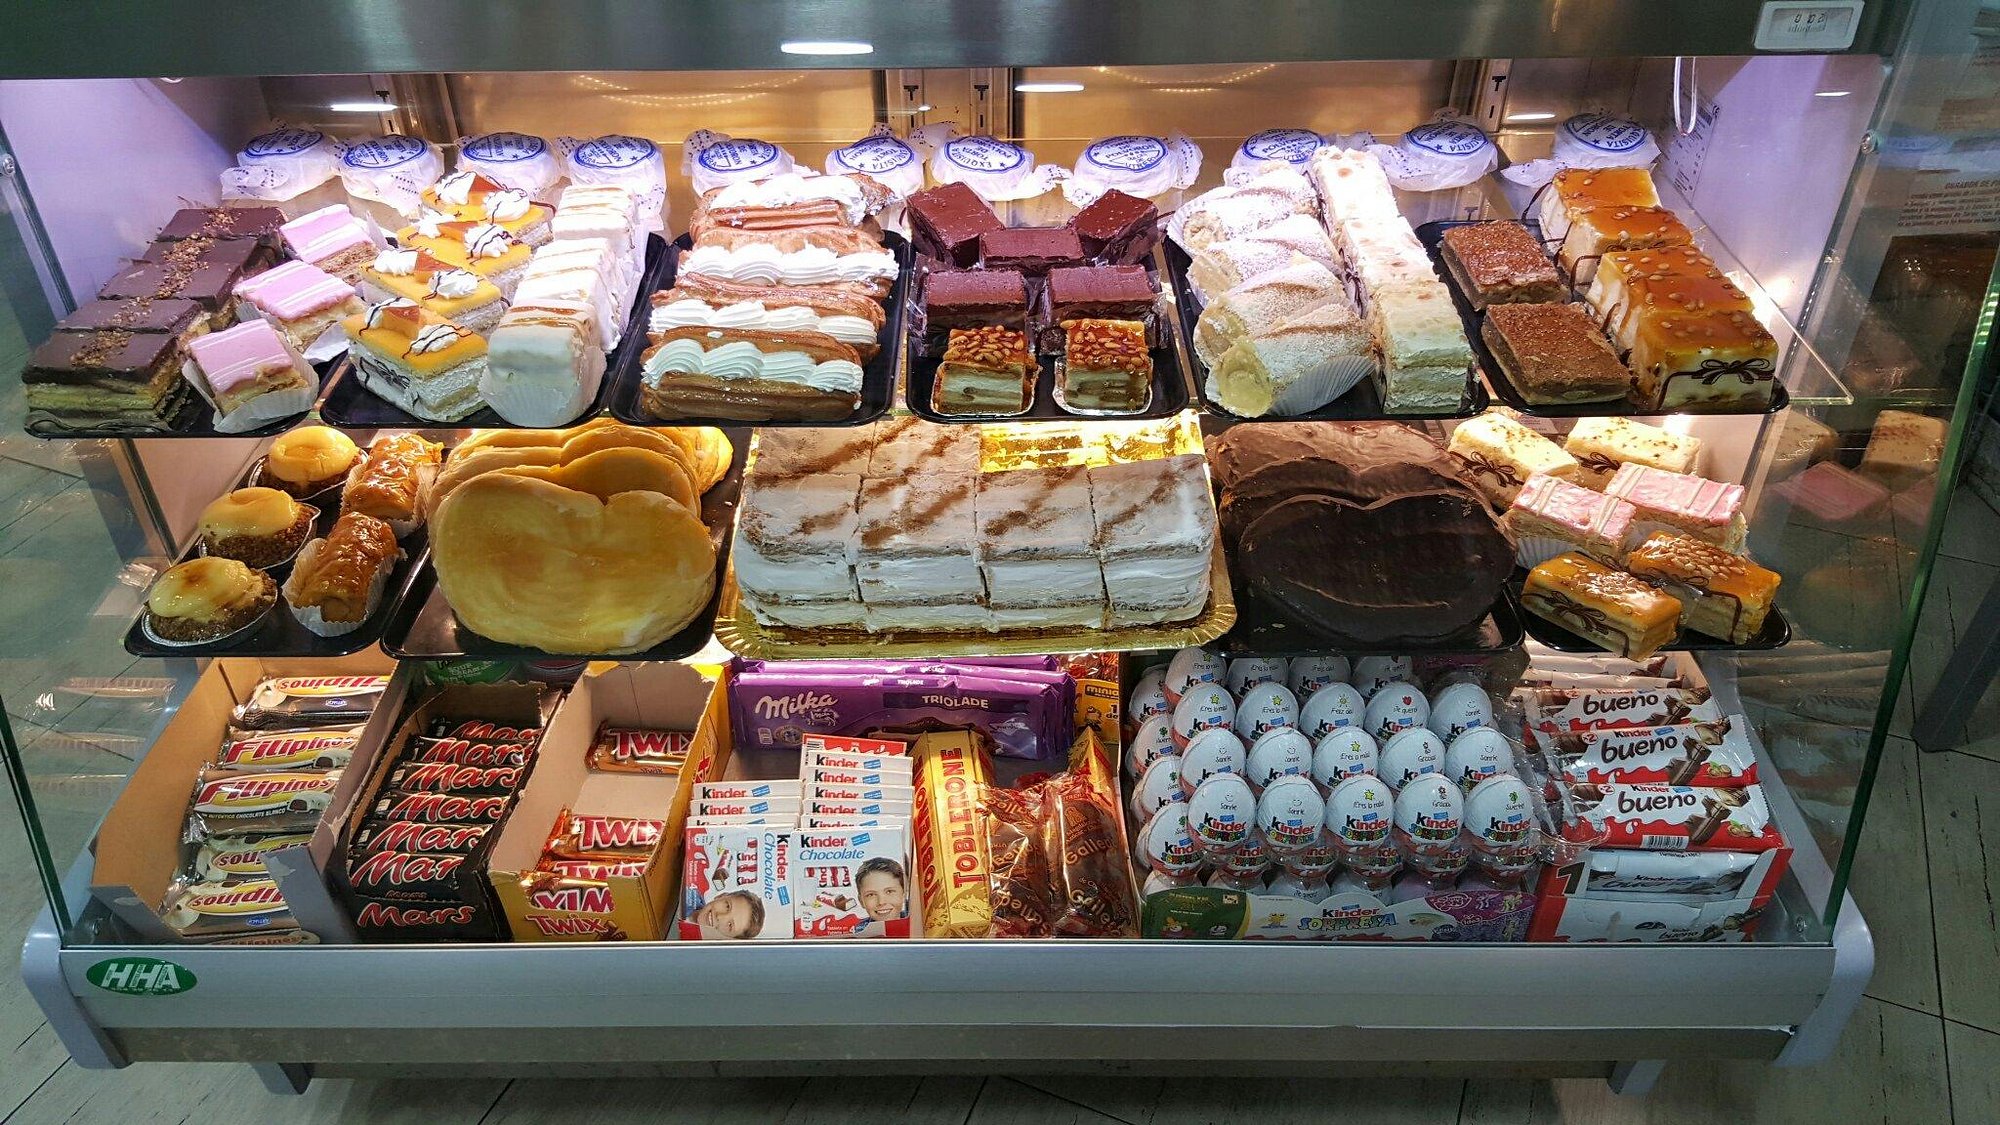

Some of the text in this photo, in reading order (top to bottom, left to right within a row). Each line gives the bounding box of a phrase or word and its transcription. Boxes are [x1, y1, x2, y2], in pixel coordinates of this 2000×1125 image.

[755, 691, 839, 719] Milka
[921, 695, 990, 710] TRIOLADE
[1583, 694, 1659, 716] bueno
[449, 720, 543, 740] Mar
[1601, 735, 1678, 764] bueno
[197, 778, 330, 805] Filipinos
[1618, 791, 1697, 814] bueno
[940, 748, 986, 889] TOBLERONE
[366, 821, 484, 853] Mar
[764, 832, 776, 900] Chocolate
[799, 848, 865, 861] Chocolate
[350, 850, 465, 888] Mar
[531, 887, 616, 913] WIX
[357, 902, 476, 928] Mars
[1298, 912, 1398, 933] SORPRESA
[101, 962, 180, 989] HHA
